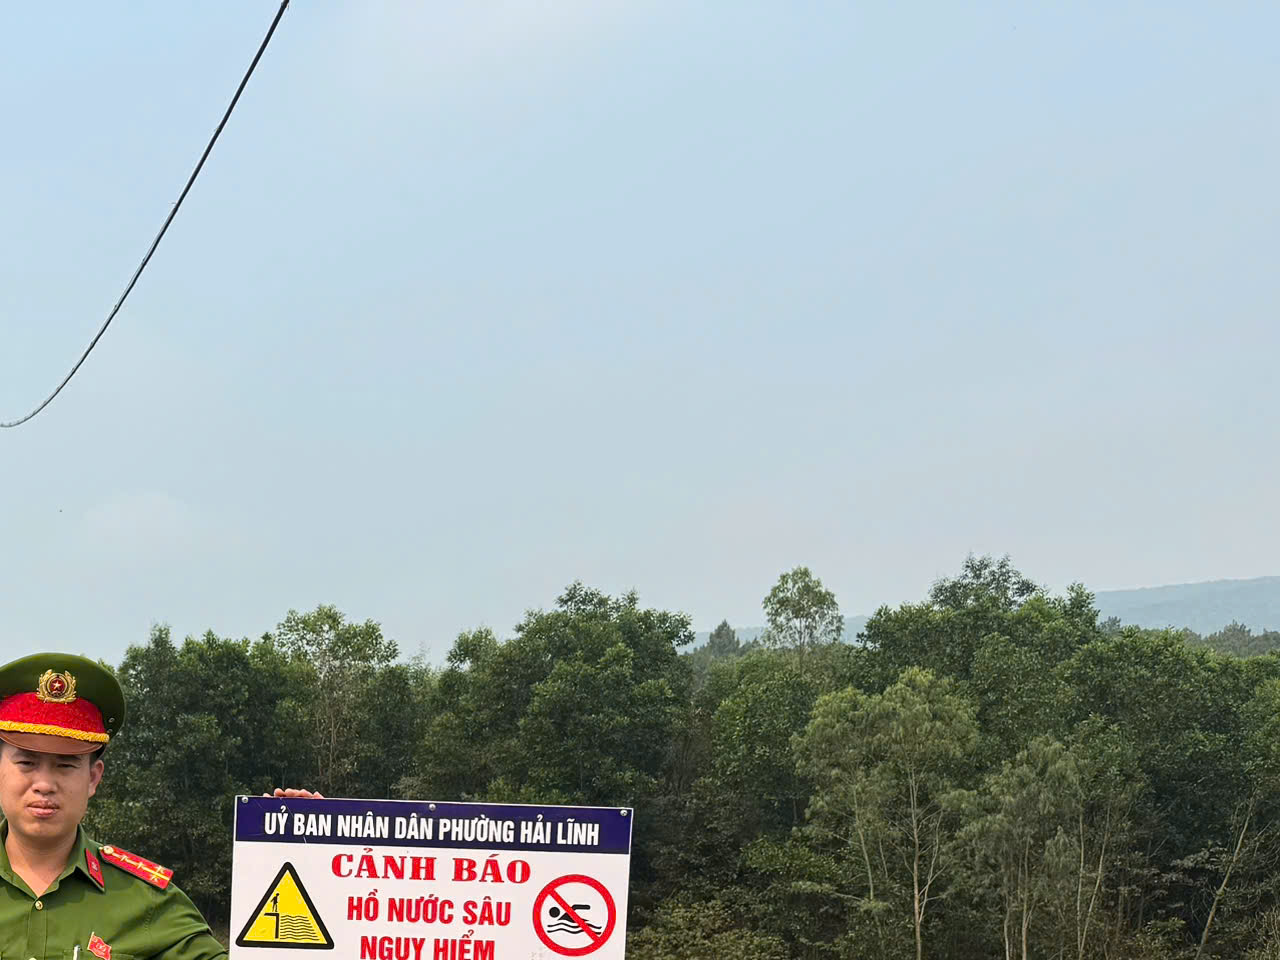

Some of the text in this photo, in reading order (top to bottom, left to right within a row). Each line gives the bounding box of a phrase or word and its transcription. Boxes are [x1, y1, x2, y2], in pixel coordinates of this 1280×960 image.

[264, 805, 600, 846] UỶ BAN NHÂN DÂN PHƯỜNG HẢI LĨNH
[331, 847, 532, 884] CẢNH BÁO
[347, 888, 512, 927] HỒ NƯỚC SÂU
